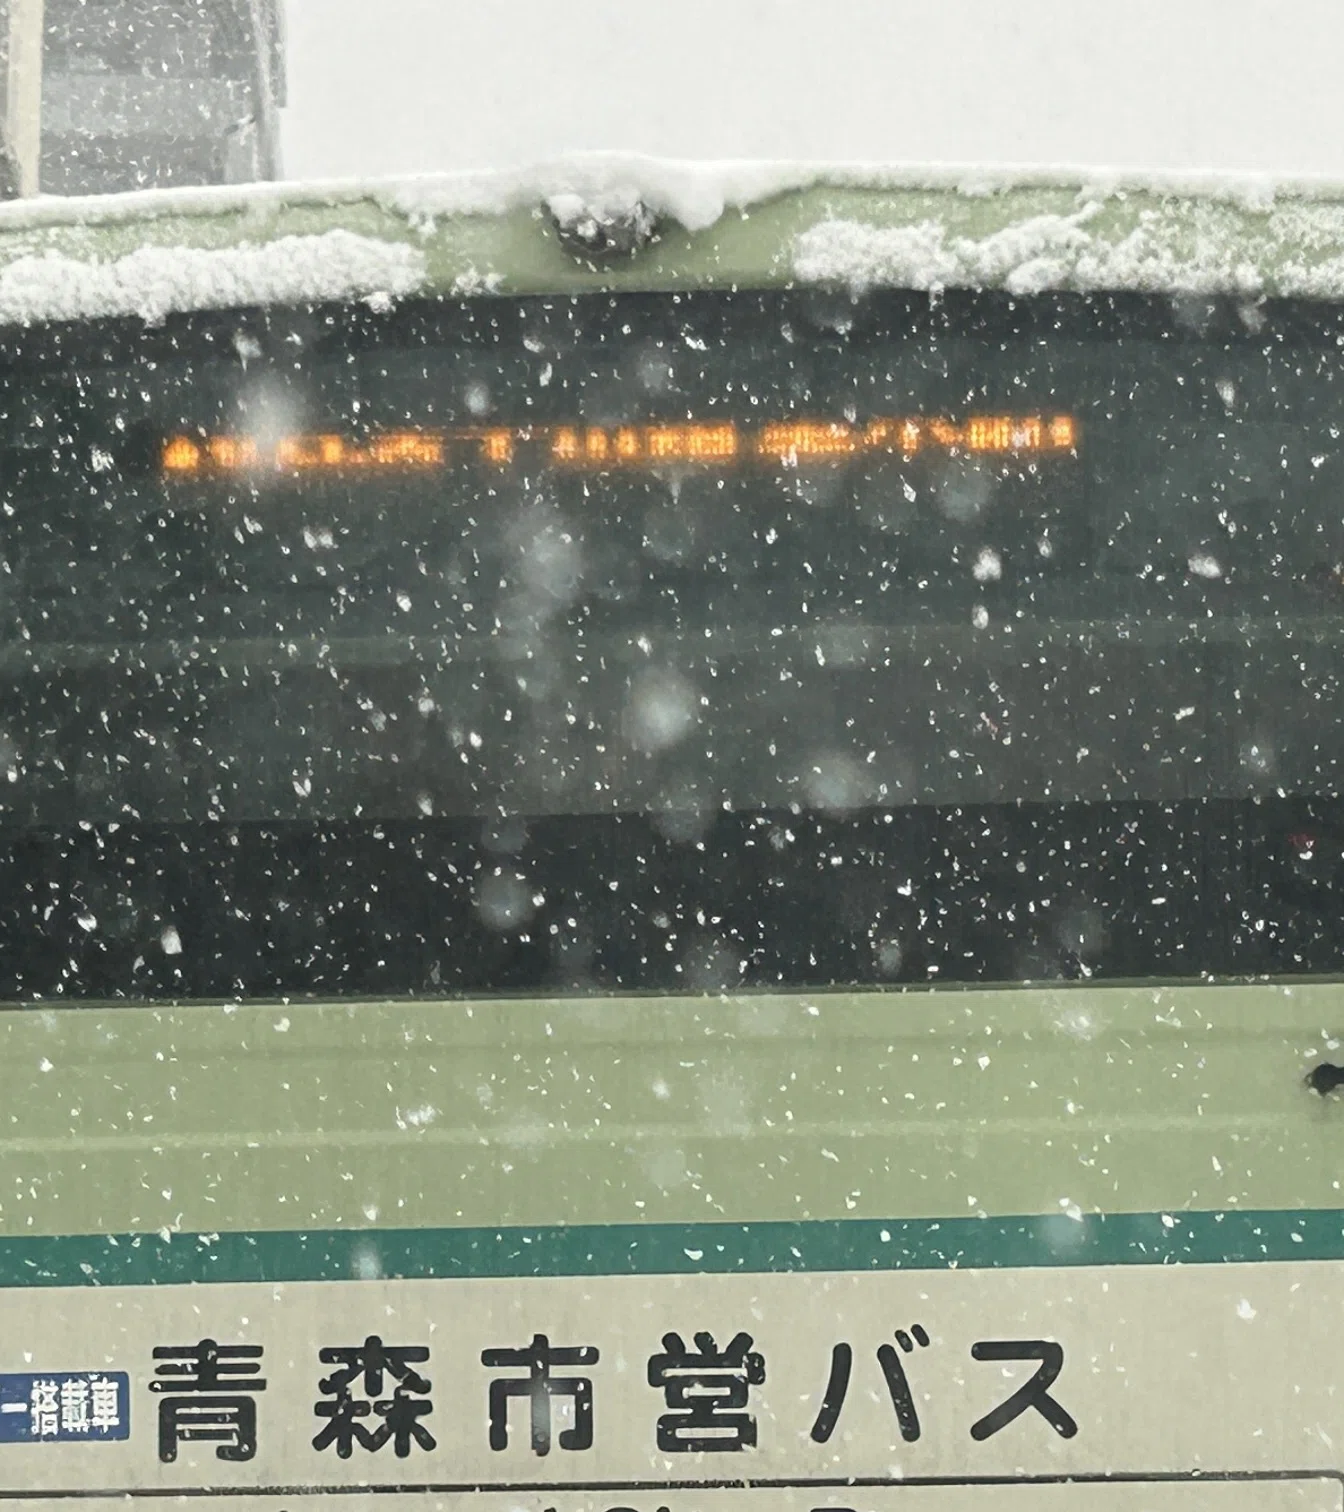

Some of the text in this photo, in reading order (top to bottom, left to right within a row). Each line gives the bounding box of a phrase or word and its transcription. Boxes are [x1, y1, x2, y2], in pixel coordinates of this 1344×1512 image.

[149, 1325, 1079, 1463] 青森市営バス
